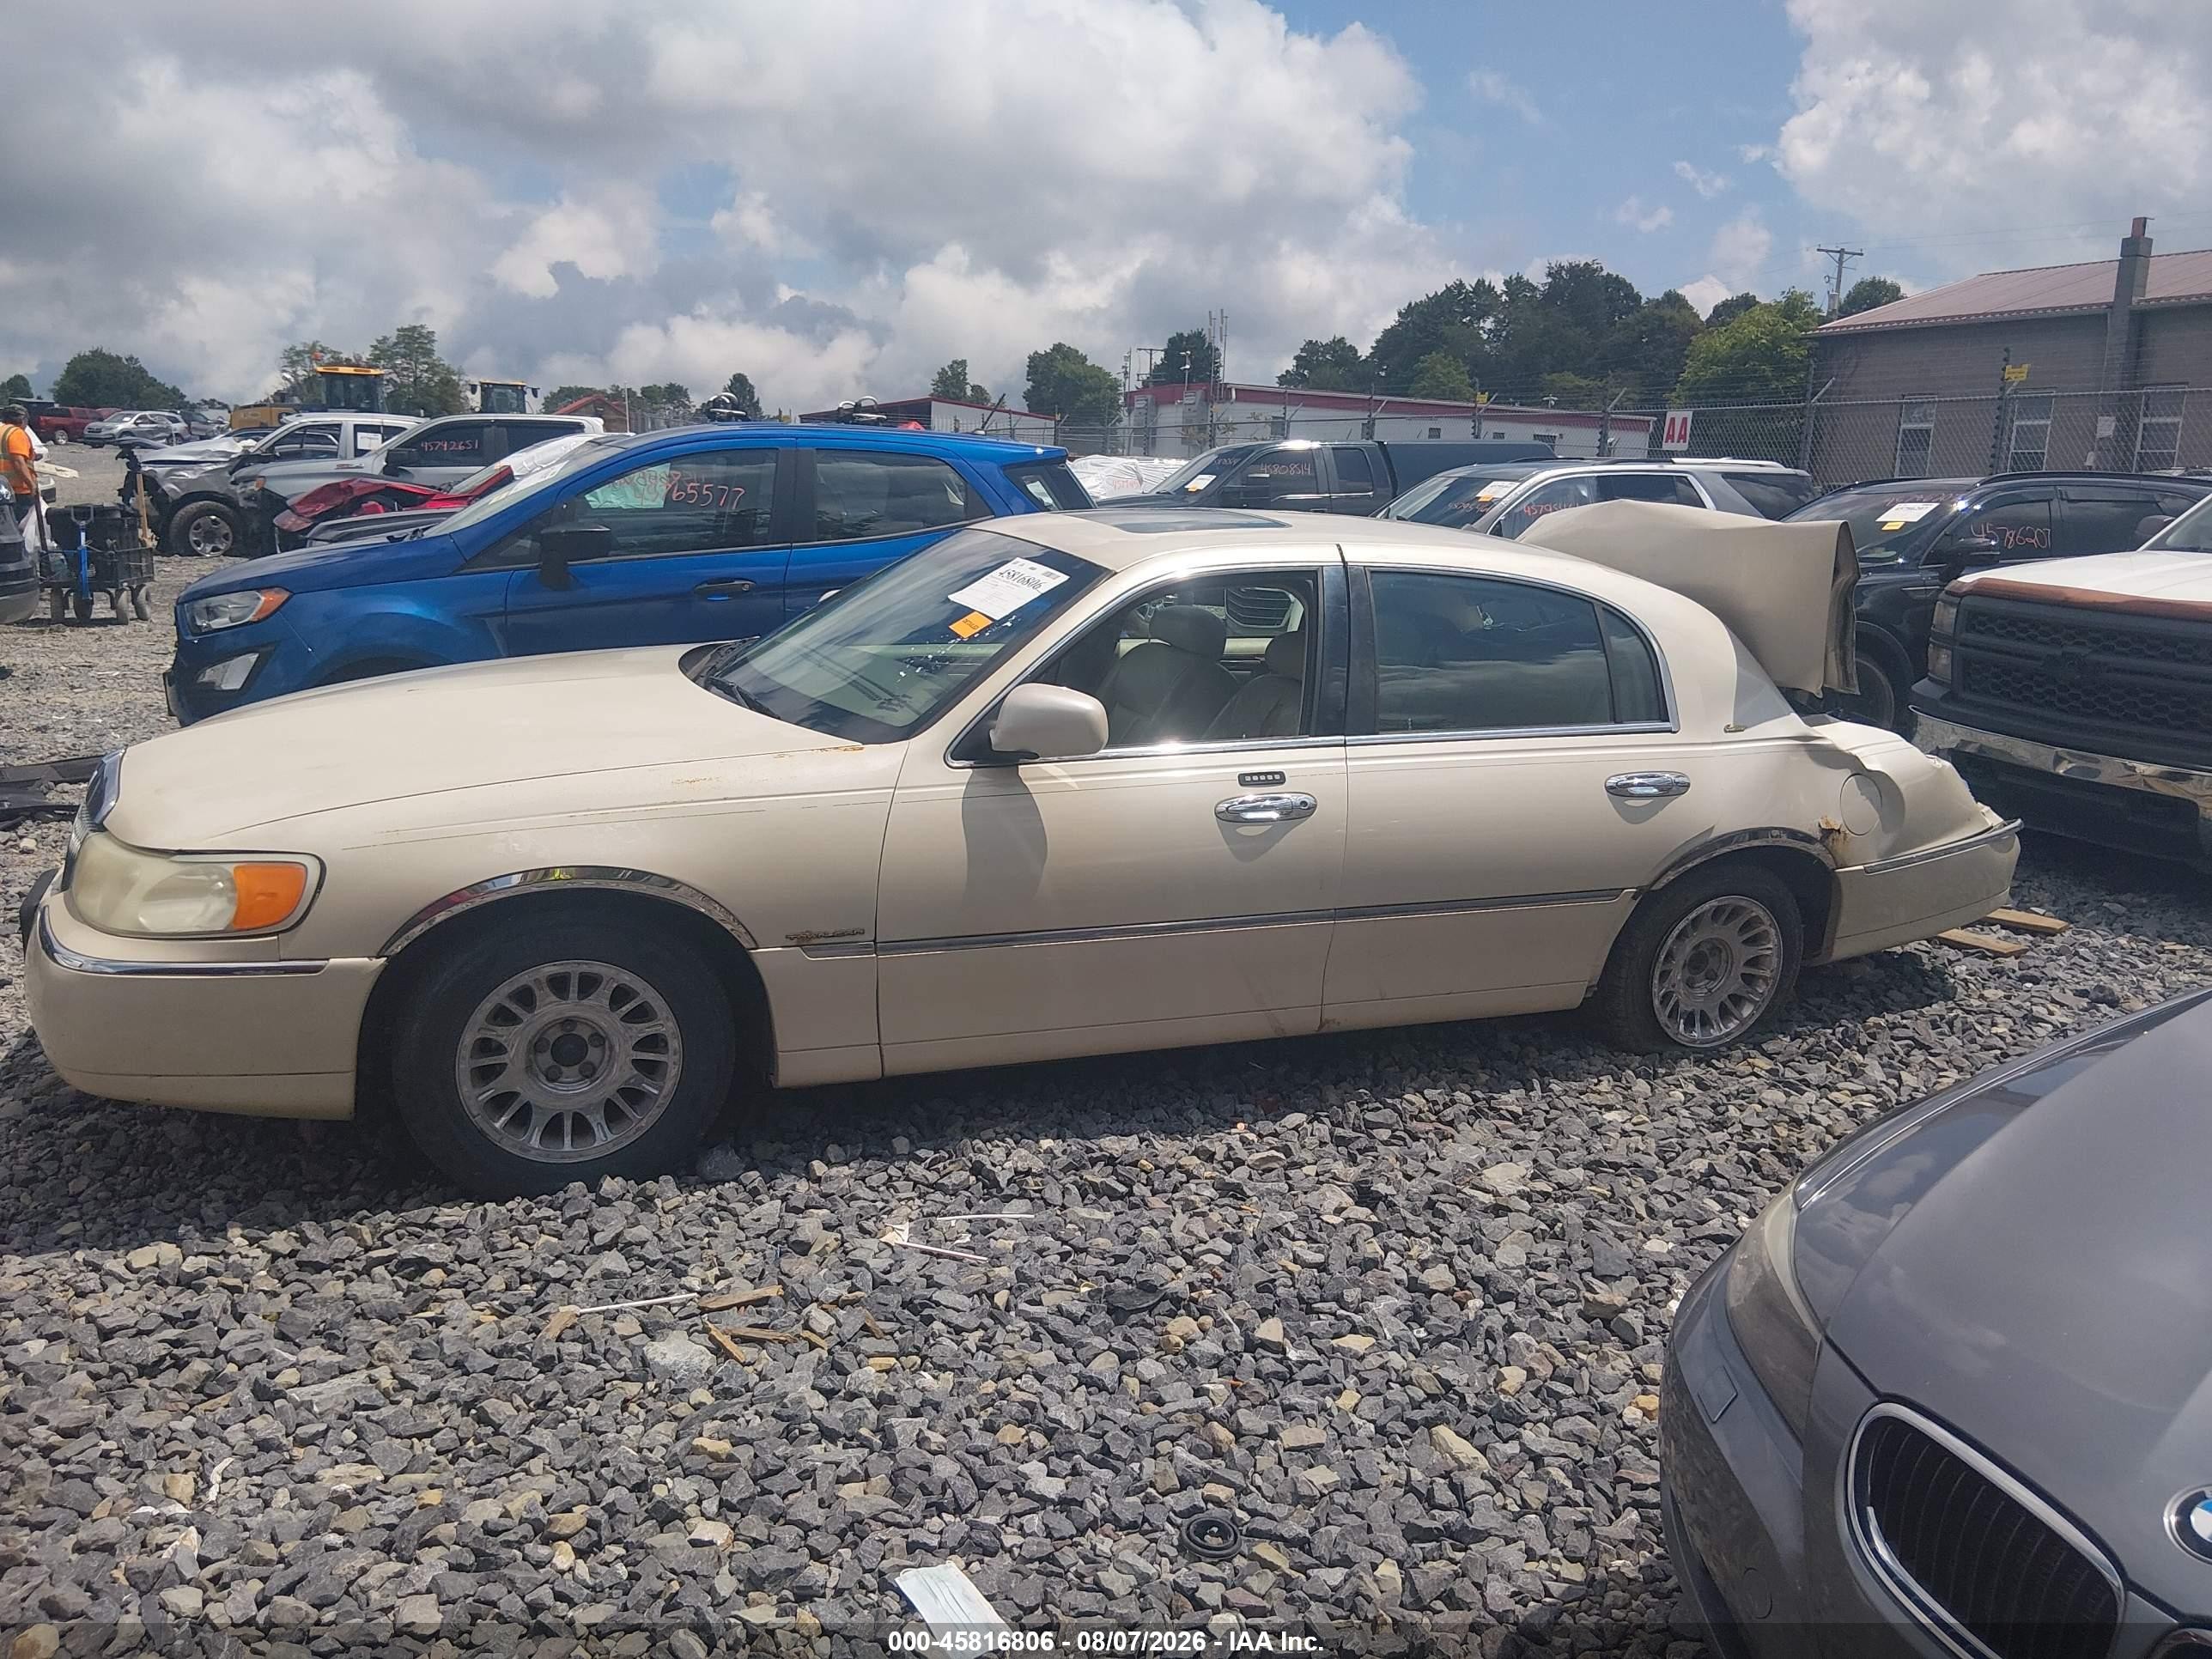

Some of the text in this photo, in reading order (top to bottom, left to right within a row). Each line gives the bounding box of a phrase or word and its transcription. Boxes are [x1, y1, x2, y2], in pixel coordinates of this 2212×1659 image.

[1664, 416, 1688, 443] AA
[421, 440, 478, 452] 45742651
[1260, 460, 1311, 475] 45808514
[1971, 522, 2051, 550] 45786207
